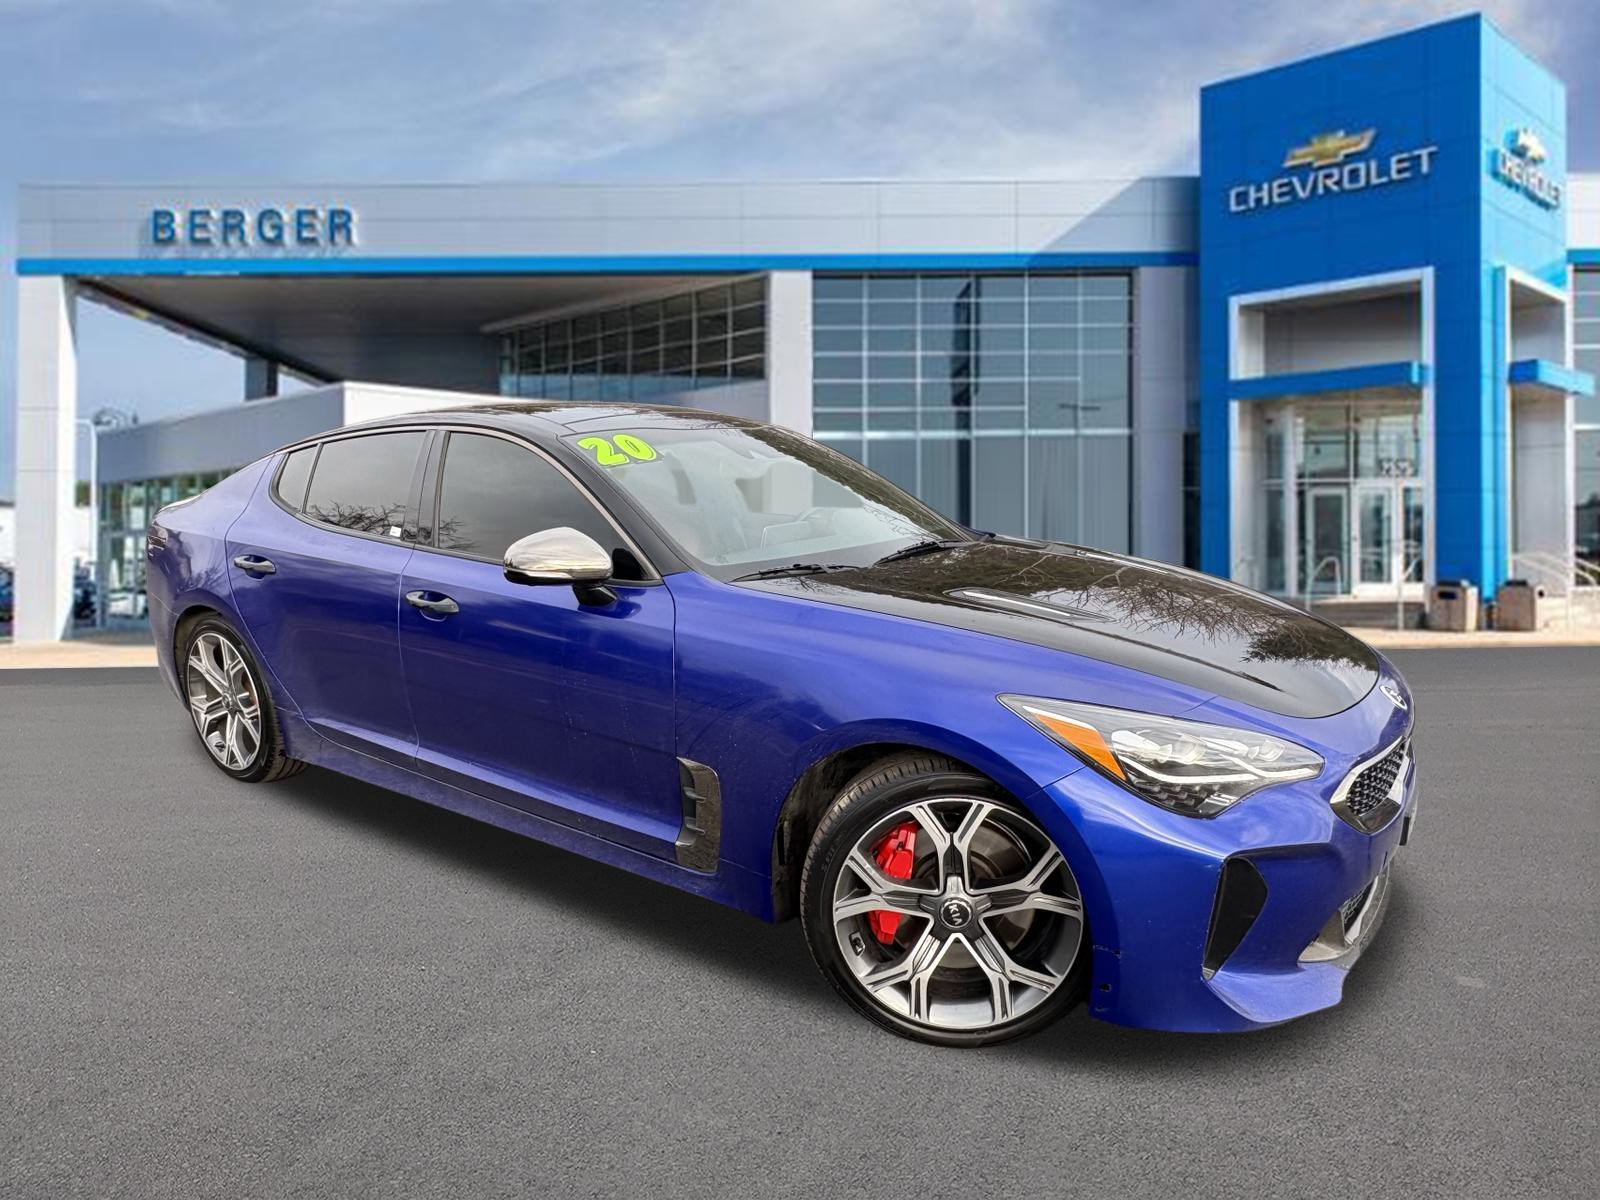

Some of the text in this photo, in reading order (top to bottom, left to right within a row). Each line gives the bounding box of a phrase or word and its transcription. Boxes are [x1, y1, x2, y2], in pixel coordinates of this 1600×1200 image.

[1229, 146, 1438, 212] CHEVROLET
[152, 208, 356, 246] BERGER
[577, 434, 657, 466] 20
[948, 904, 963, 926] KIA
